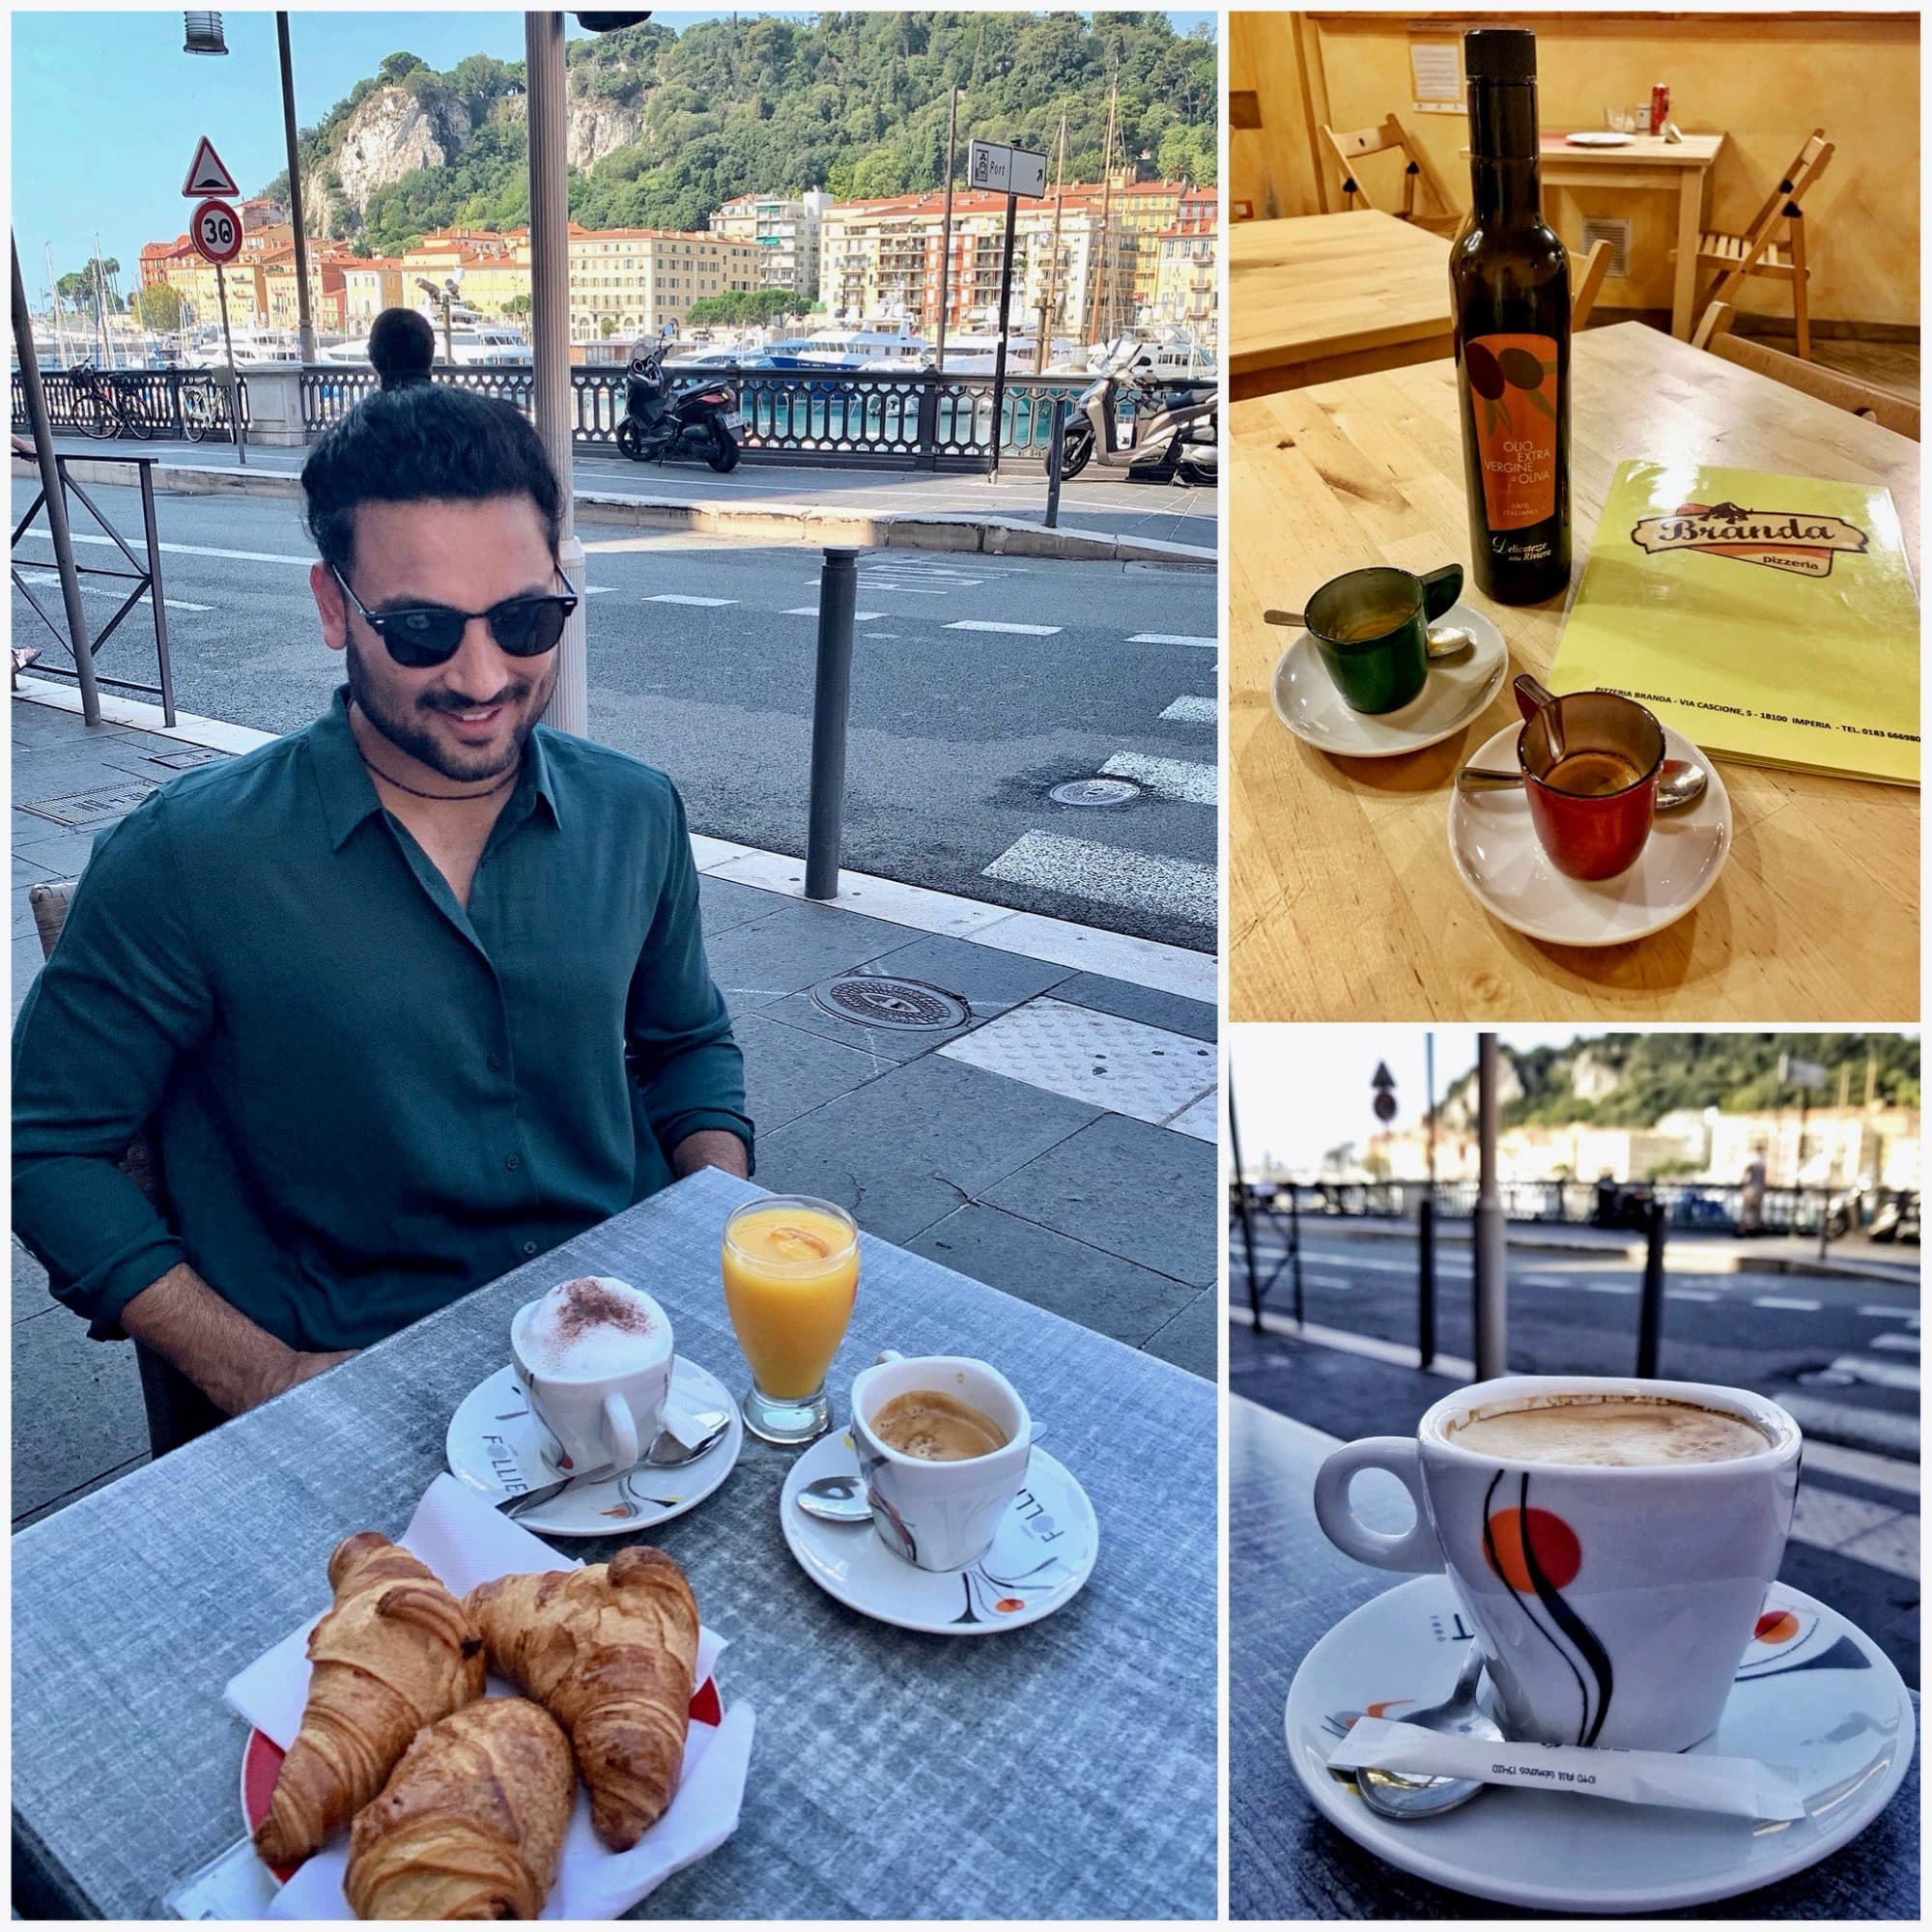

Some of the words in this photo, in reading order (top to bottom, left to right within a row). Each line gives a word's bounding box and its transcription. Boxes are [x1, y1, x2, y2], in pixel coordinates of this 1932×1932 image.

[990, 161, 1005, 176] Port
[204, 218, 233, 243] 30
[1503, 440, 1533, 452] OLIO
[1518, 449, 1550, 462] EXTRA
[1484, 460, 1534, 472] VERGINE
[1519, 470, 1550, 484] OLIVA
[1659, 518, 1835, 541] Branda
[1763, 554, 1819, 570] pizzeria
[1595, 687, 1632, 697] PIZZERIA
[1634, 693, 1671, 703] BRANDA
[1680, 698, 1695, 707] VIA
[1696, 702, 1745, 716] CASCIONE,
[1760, 712, 1788, 723] 18100
[1792, 717, 1832, 729] IMPERIA
[1841, 724, 1861, 734] TEL.
[1861, 727, 1886, 738] 0183
[482, 1435, 528, 1498] FOLLIE
